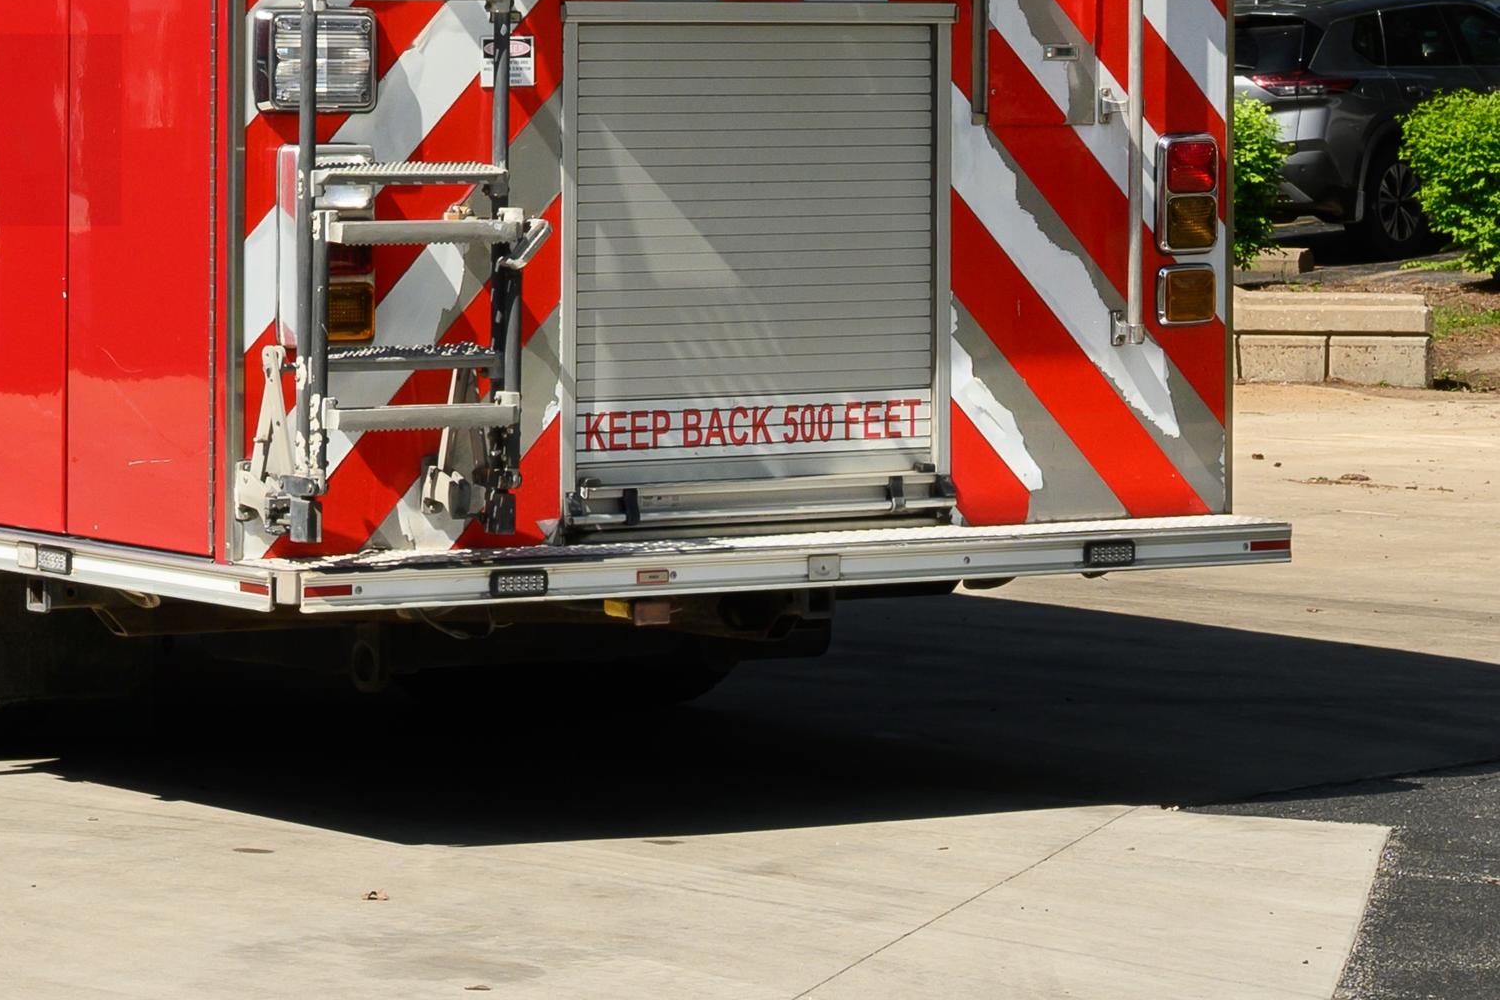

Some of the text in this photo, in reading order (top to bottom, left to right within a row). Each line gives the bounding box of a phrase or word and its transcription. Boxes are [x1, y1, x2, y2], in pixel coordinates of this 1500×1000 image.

[585, 398, 921, 452] KEEP BACK 500 FEET
